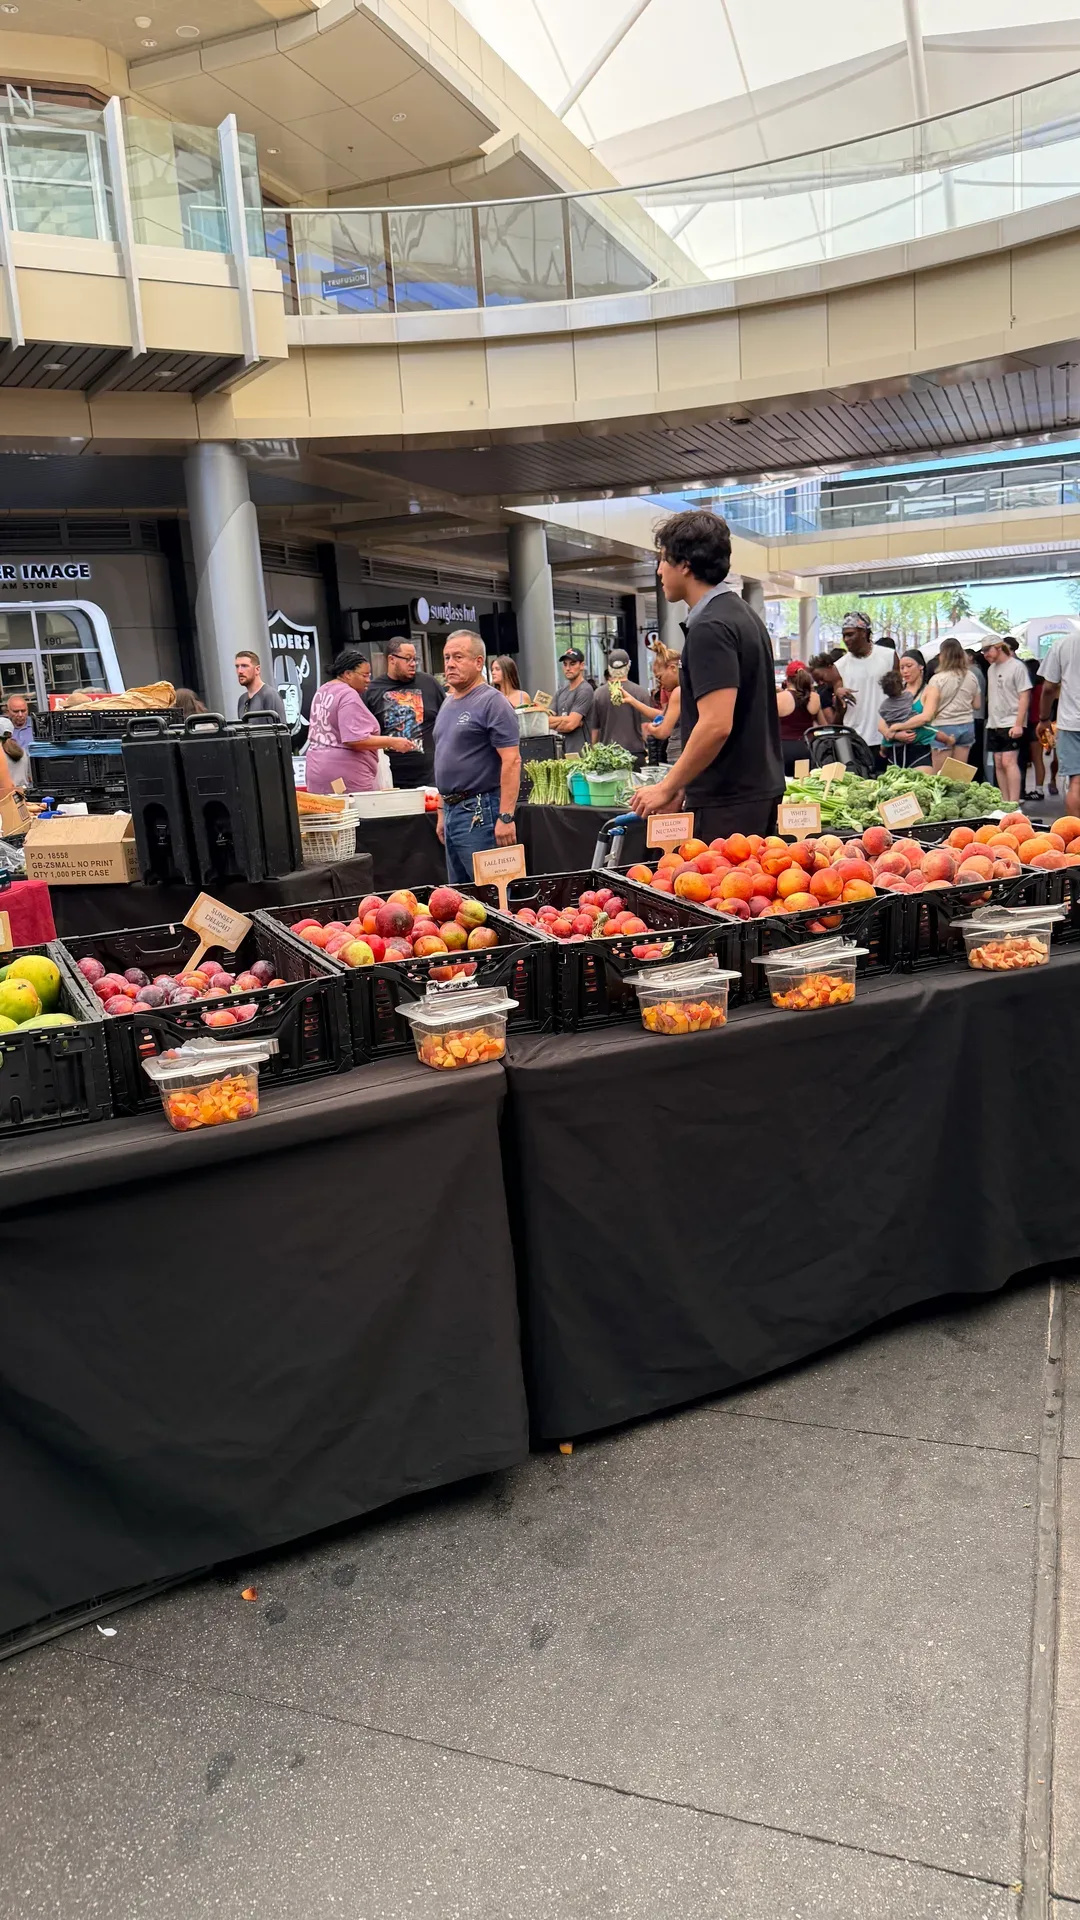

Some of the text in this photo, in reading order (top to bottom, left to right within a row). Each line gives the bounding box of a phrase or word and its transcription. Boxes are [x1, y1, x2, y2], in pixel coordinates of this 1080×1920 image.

[327, 274, 366, 287] TRUFUSION
[0, 563, 91, 580] R IMAGE
[23, 582, 58, 590] STORE
[430, 602, 477, 625] sunglass hut
[44, 637, 62, 646] 190
[270, 633, 311, 650] IDERS
[30, 851, 69, 860] P.O. 18558
[498, 857, 516, 865] FIESTA
[31, 859, 114, 869] GB-ZSMALL NO PRINT
[33, 871, 49, 879] QTY
[50, 870, 70, 879] 1,000
[88, 869, 110, 877] CASE
[210, 907, 235, 924] SUNSET
[204, 914, 232, 932] DELIGHT
